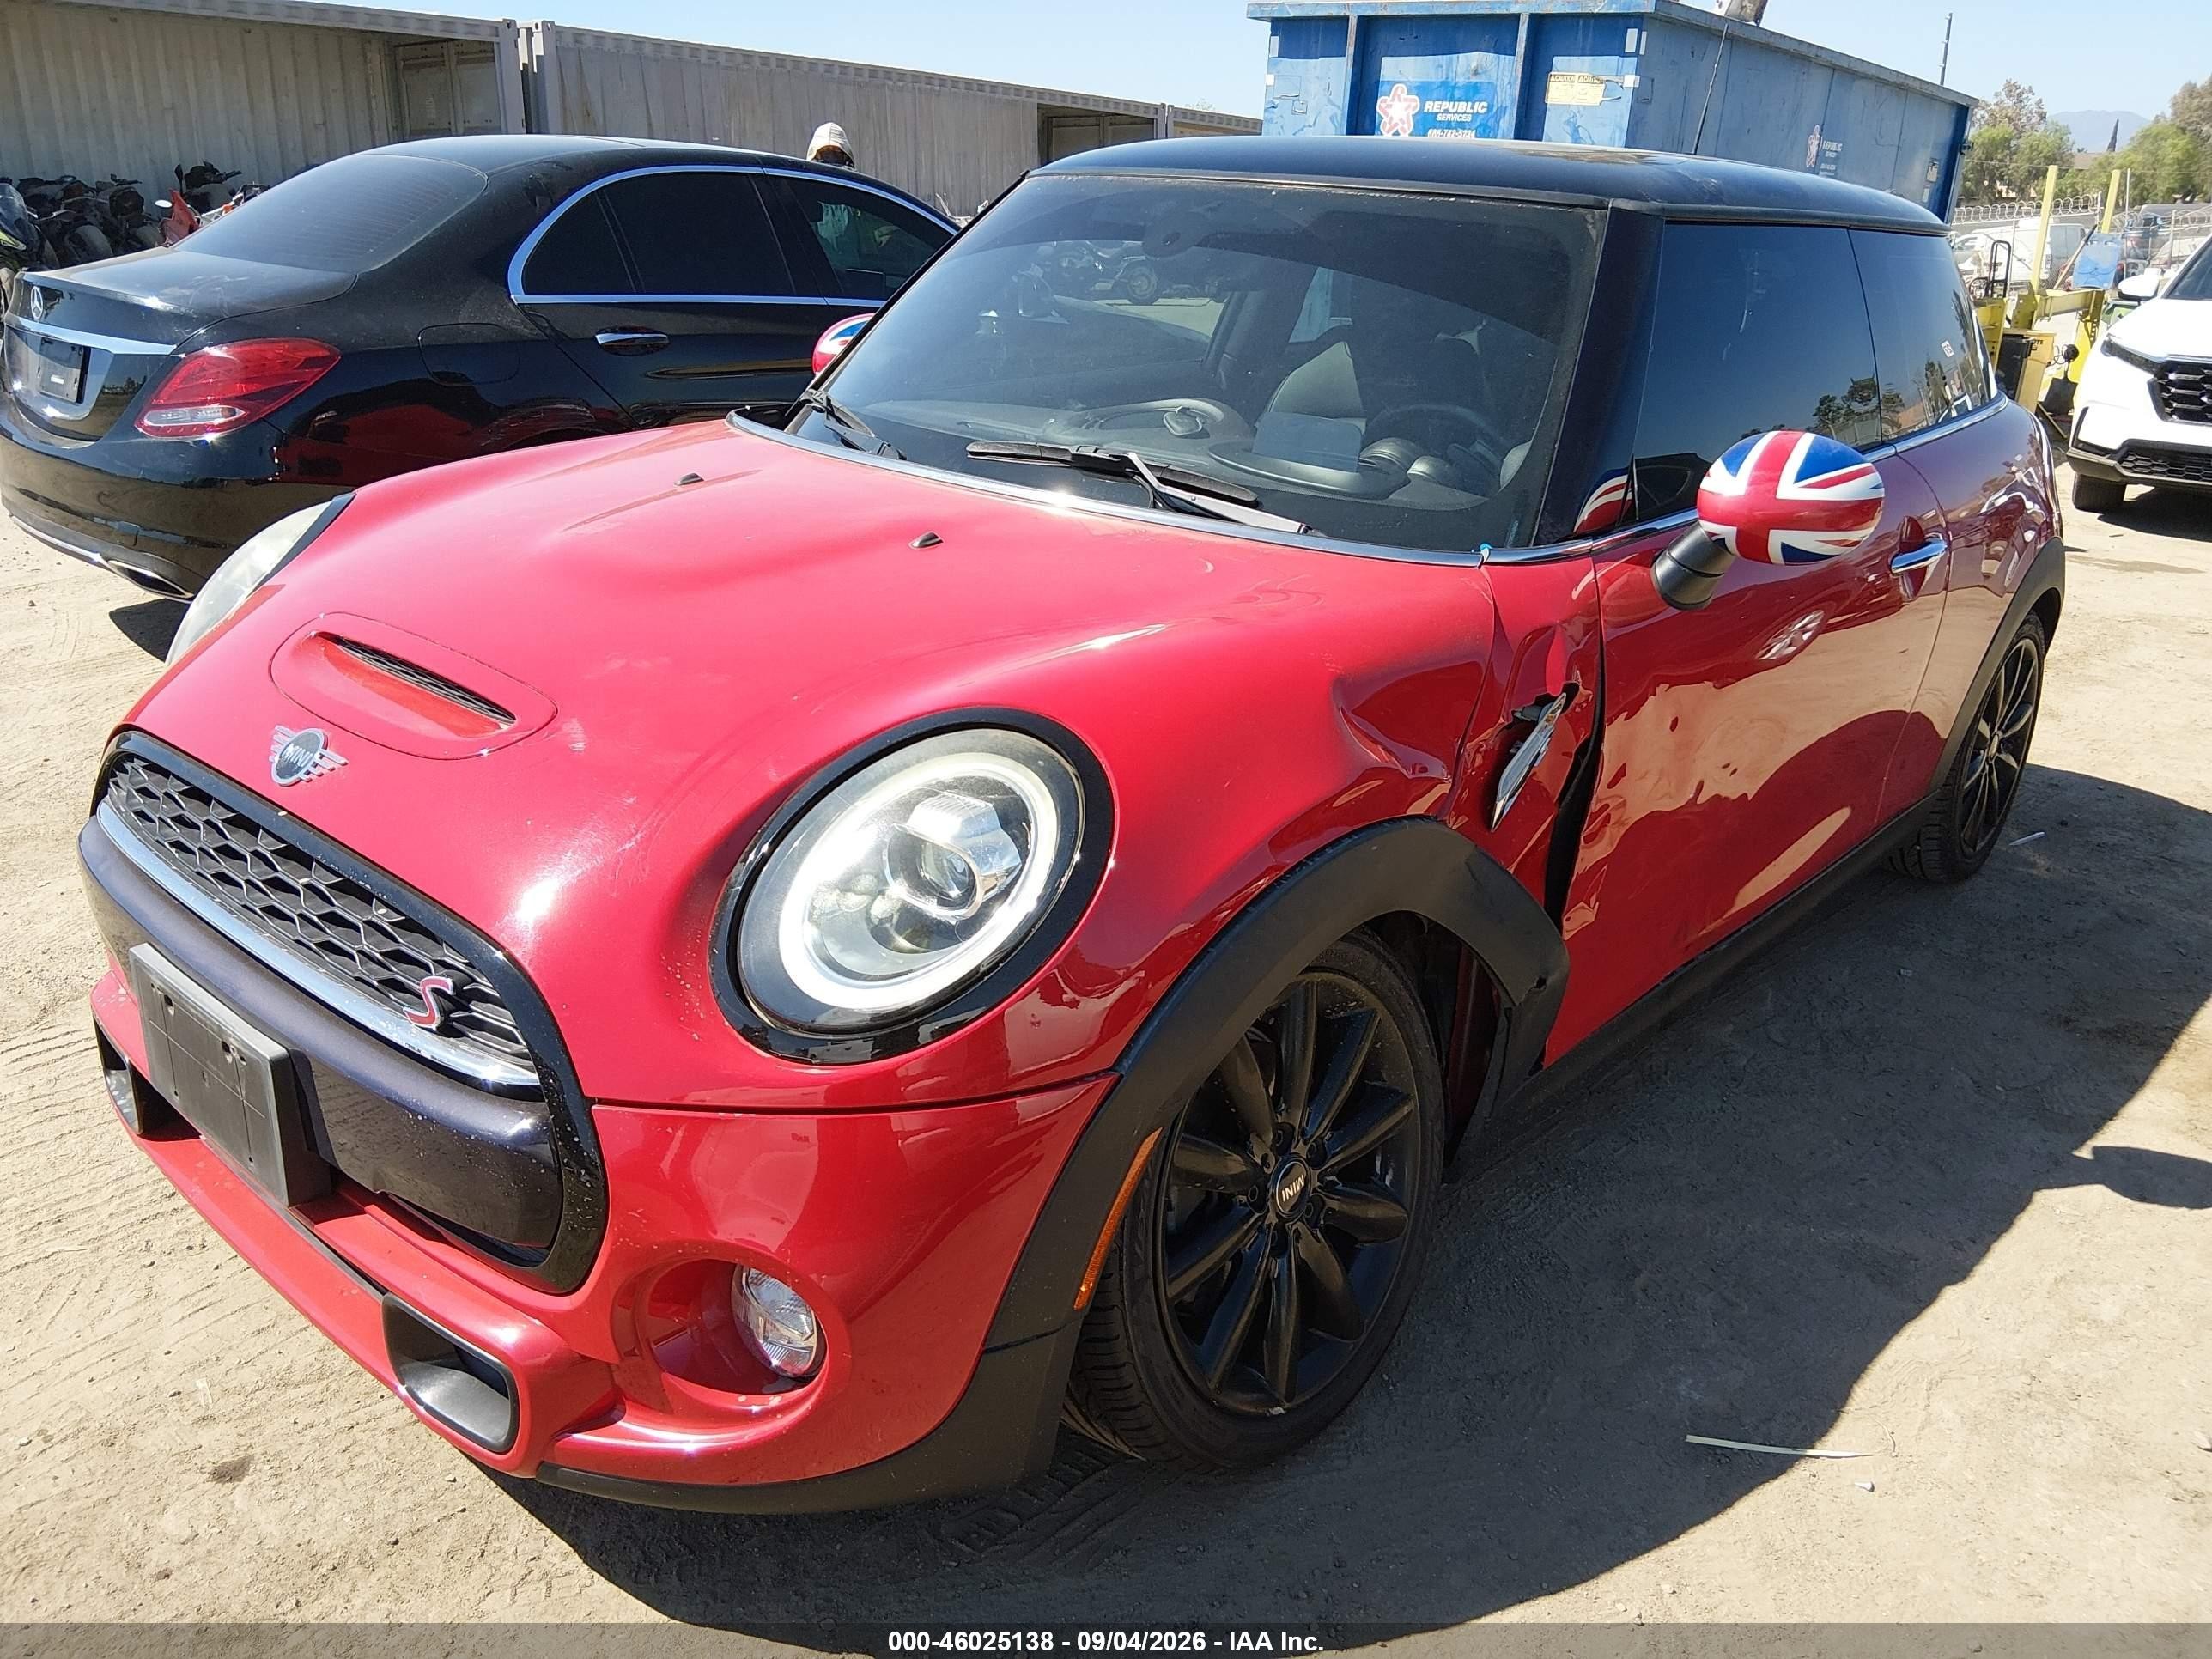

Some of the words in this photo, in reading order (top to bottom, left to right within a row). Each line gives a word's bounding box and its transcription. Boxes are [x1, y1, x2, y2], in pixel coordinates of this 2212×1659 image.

[1424, 100, 1488, 114] REPUBLIC
[1436, 113, 1473, 122] SERVICES
[402, 975, 454, 1031] S
[1281, 1174, 1304, 1202] MINI
